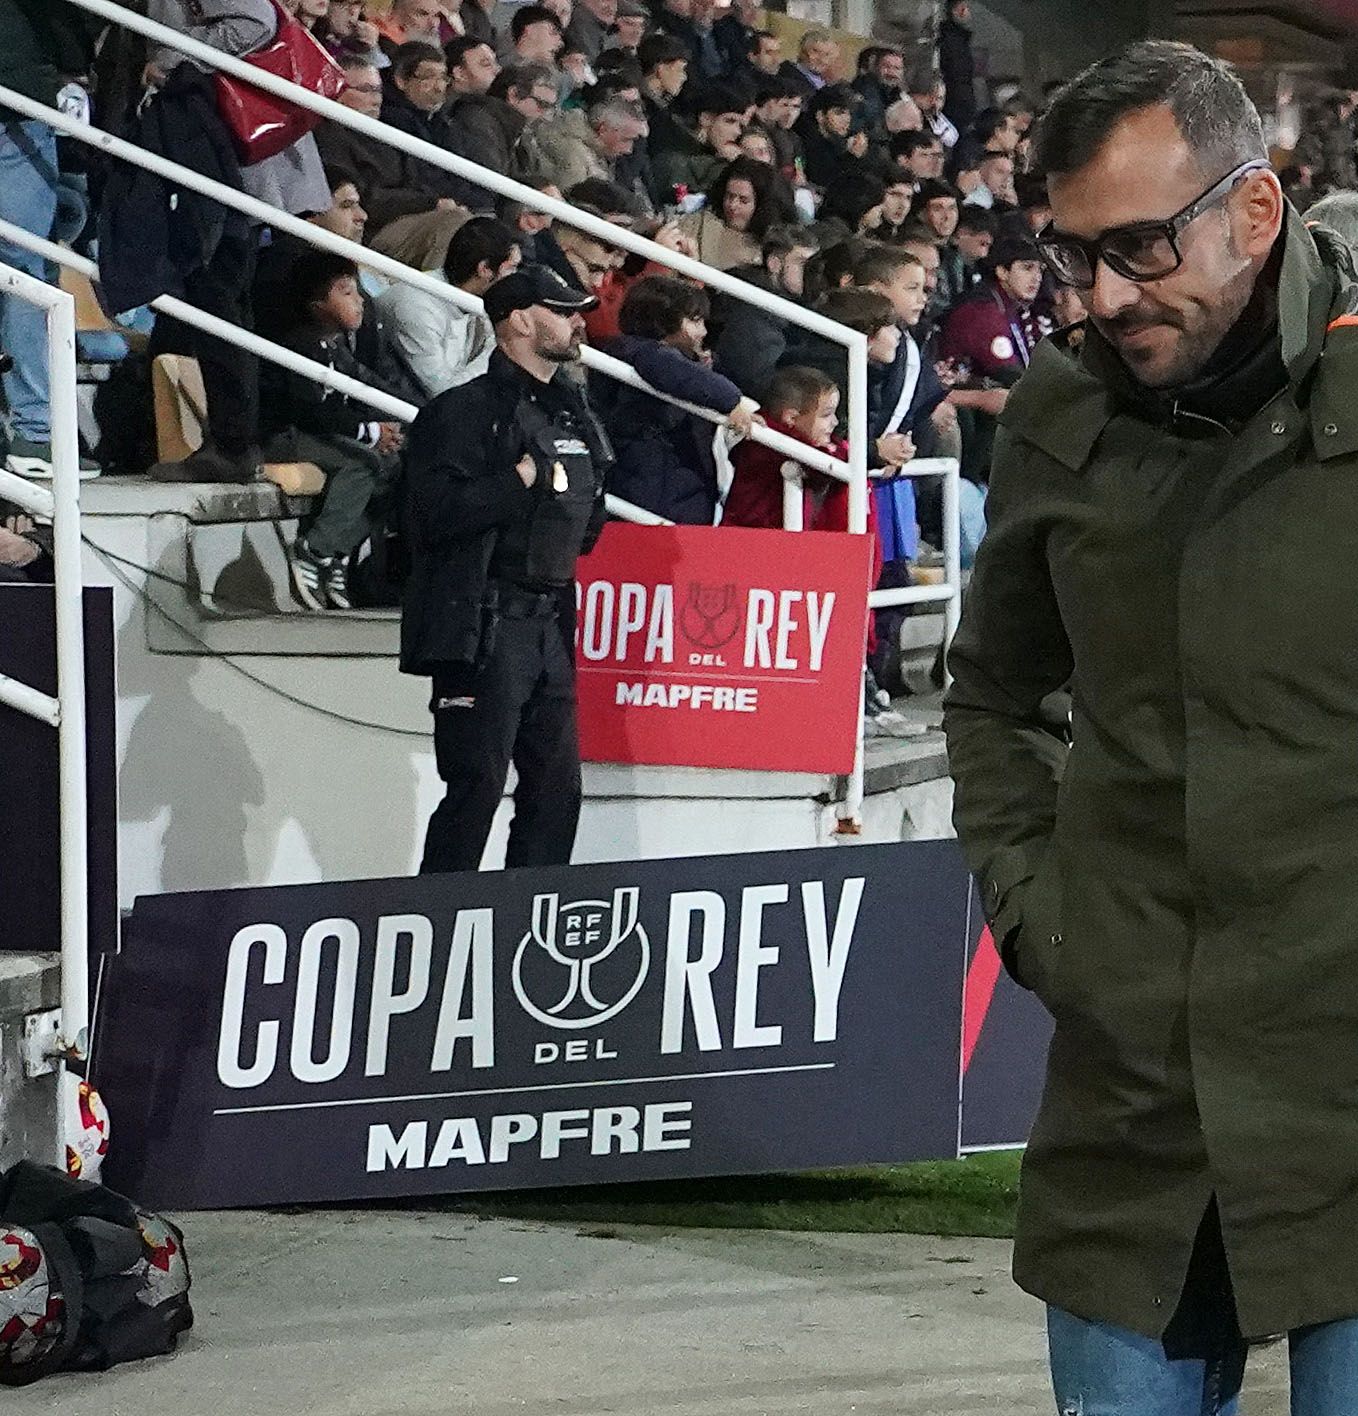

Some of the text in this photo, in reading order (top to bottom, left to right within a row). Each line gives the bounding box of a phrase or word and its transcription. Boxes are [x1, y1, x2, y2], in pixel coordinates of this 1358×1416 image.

[575, 580, 836, 671] OPA DEL REY
[615, 682, 759, 712] MAPFRE
[217, 877, 865, 1088] COPA DEL REY
[366, 1101, 693, 1173] MAPFRE
